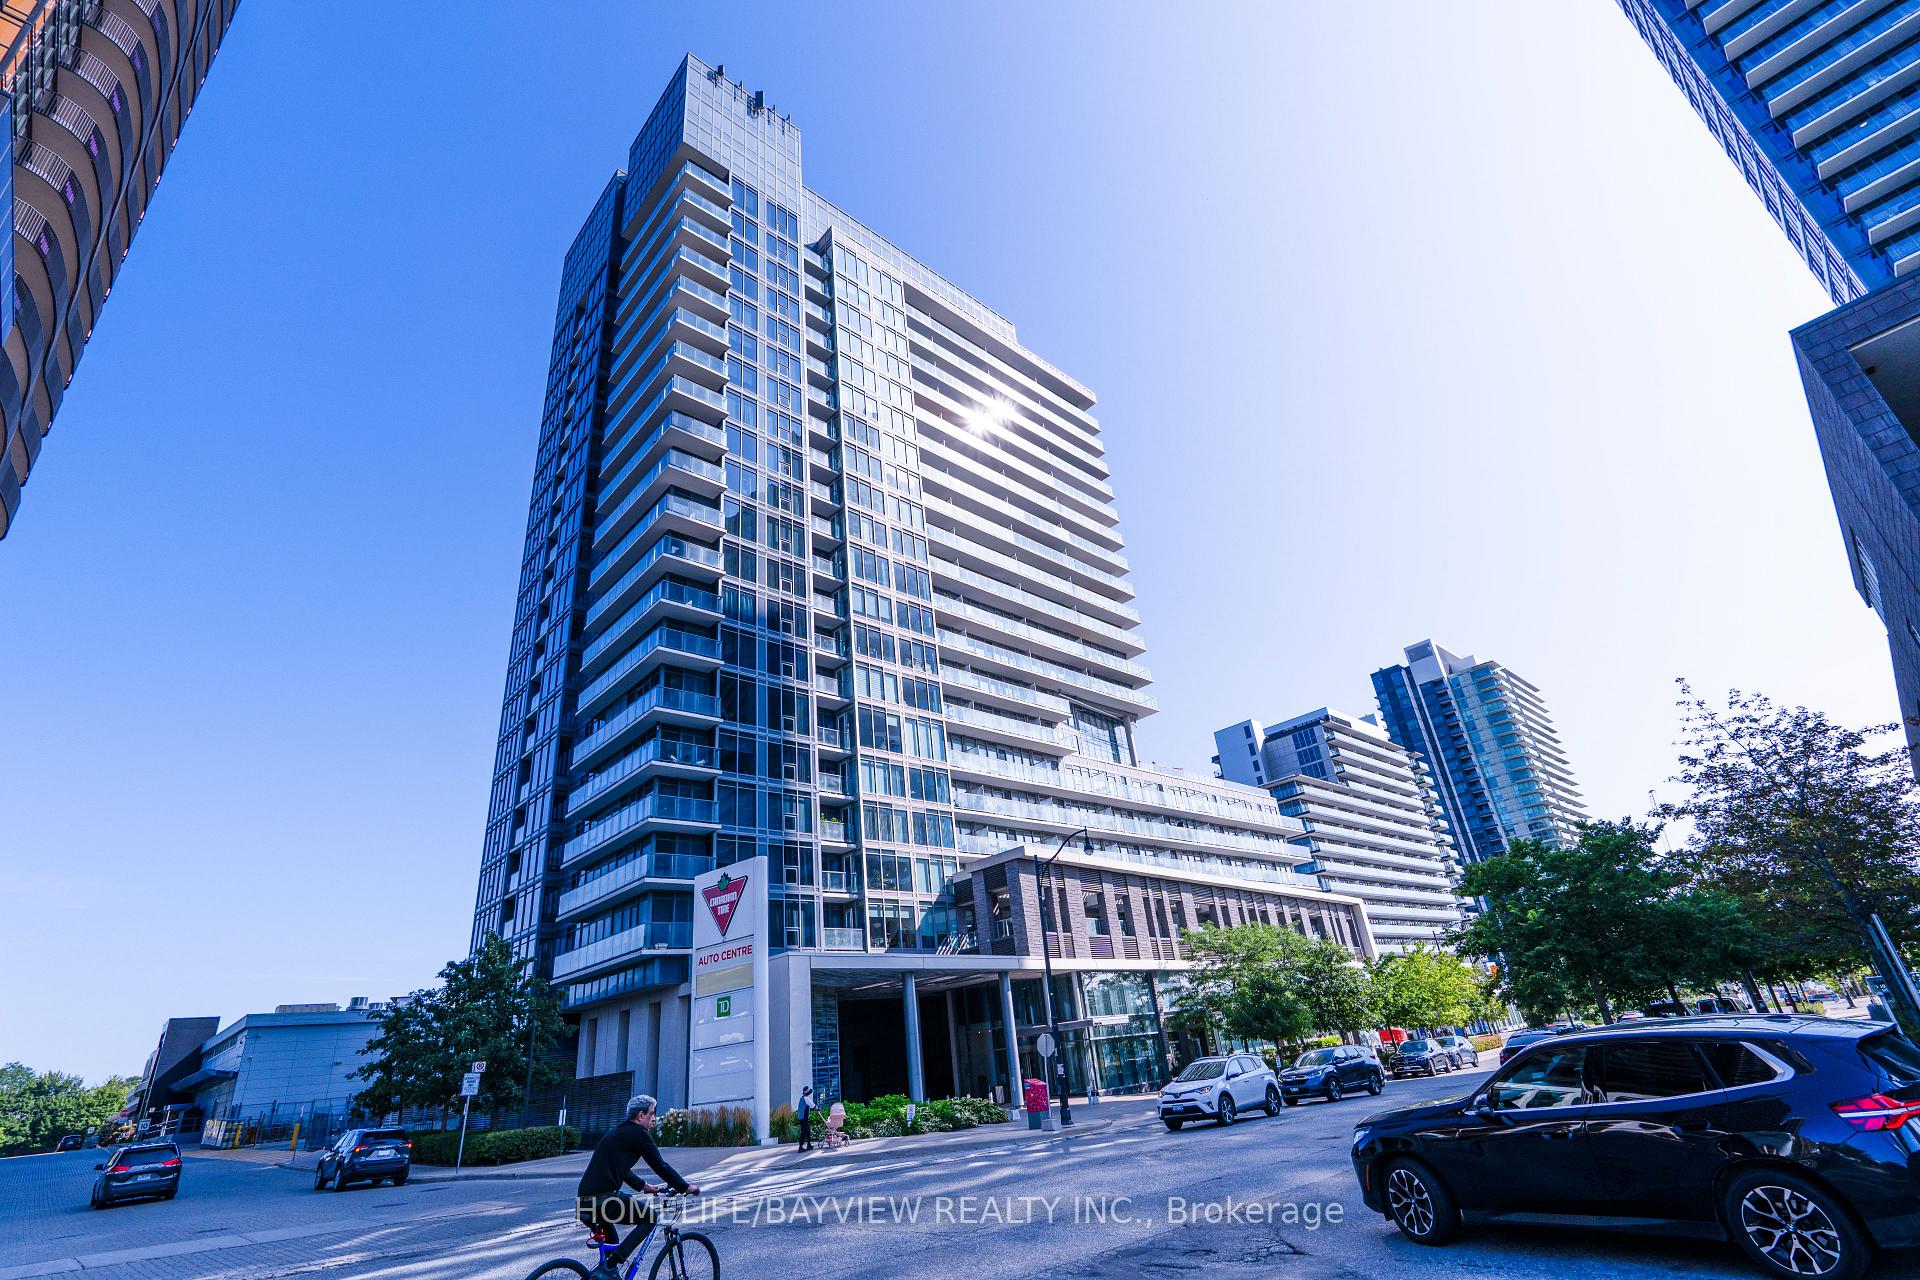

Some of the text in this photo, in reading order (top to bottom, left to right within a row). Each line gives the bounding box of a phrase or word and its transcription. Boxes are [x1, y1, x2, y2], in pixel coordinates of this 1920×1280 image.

[710, 891, 737, 907] CANADIAN
[717, 904, 730, 916] TIRE
[698, 944, 753, 966] AUTO CENTRE
[718, 1000, 730, 1013] TD
